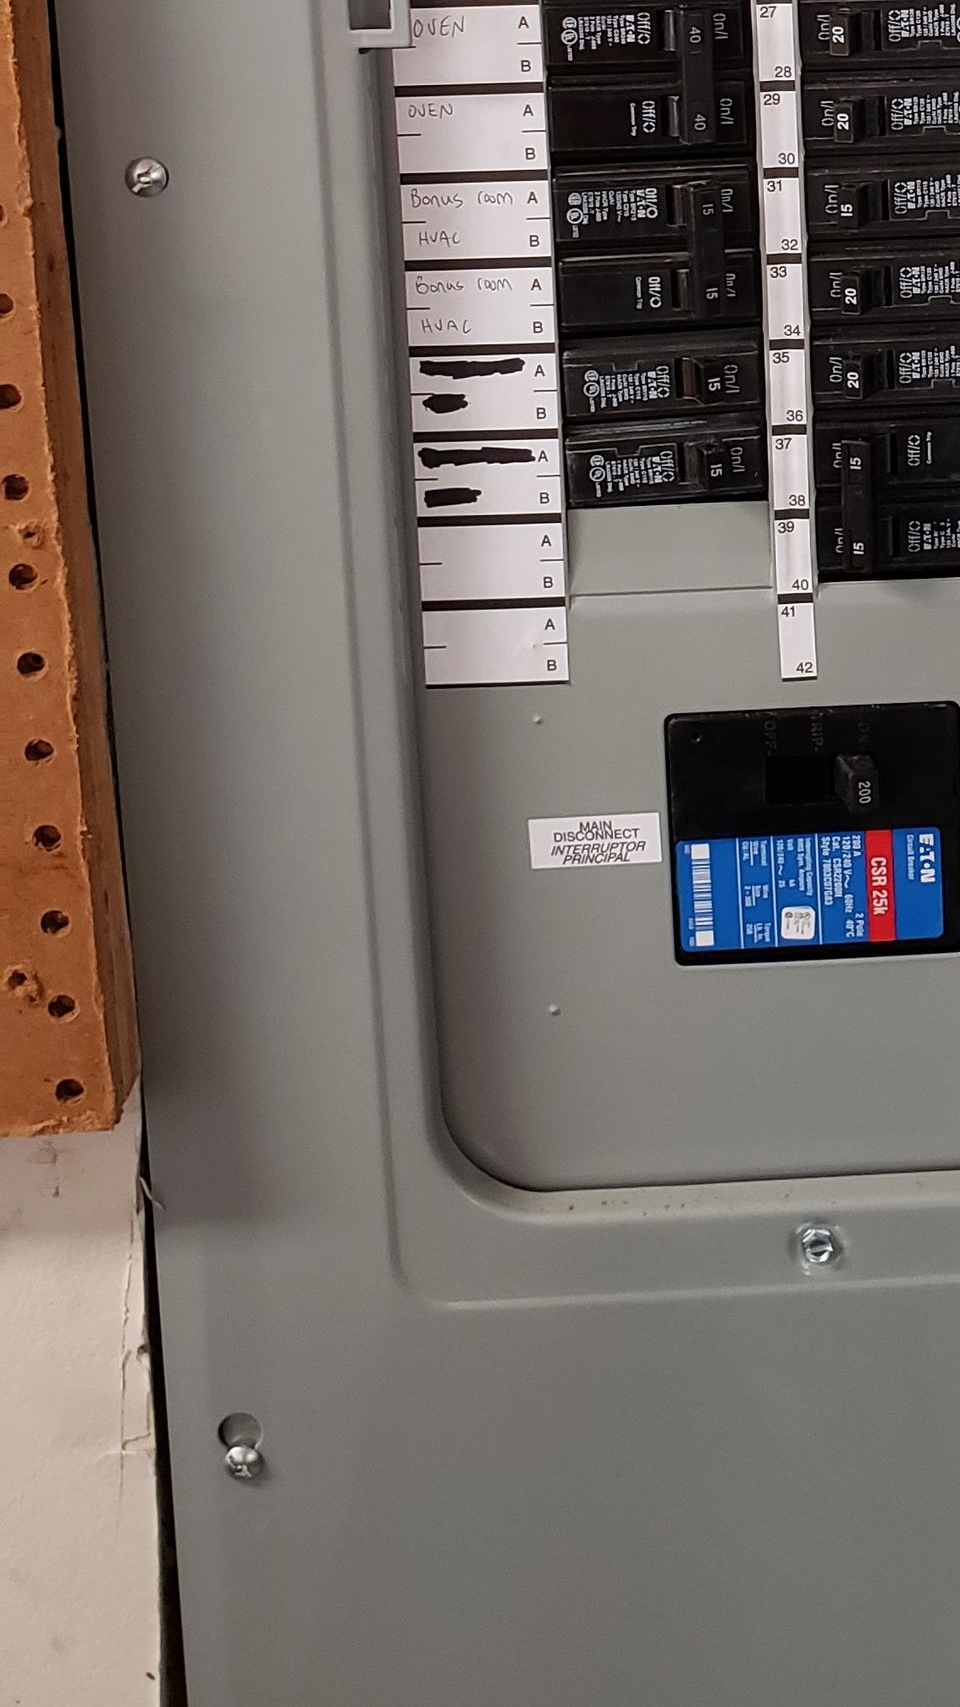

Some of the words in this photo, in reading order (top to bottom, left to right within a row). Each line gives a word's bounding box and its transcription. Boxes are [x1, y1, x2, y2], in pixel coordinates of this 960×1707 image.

[759, 5, 777, 19] 27
[413, 16, 464, 38] OVEN
[689, 26, 702, 44] 40
[831, 26, 845, 44] 20
[763, 92, 781, 106] 29
[408, 103, 452, 118] OVEN
[836, 113, 849, 131] 20
[777, 152, 796, 165] 30
[766, 179, 782, 193] 31
[769, 265, 788, 279] 33
[772, 351, 790, 365] 35
[846, 371, 860, 389] 20
[775, 437, 793, 451] 37
[849, 457, 862, 470] 15
[777, 520, 795, 534] 39
[540, 534, 552, 547] A
[791, 578, 809, 591] 40
[780, 605, 795, 618] 41
[546, 659, 558, 672] B
[795, 661, 814, 674] 42
[858, 781, 871, 804] 200
[580, 821, 612, 832] MAIN
[554, 828, 640, 842] DISCONNECT
[551, 841, 646, 856] INTERRUPTOR
[563, 853, 630, 865] PRINCIPAL
[919, 833, 935, 883] EATON
[871, 857, 887, 886] CSR
[872, 891, 888, 915] 25k
